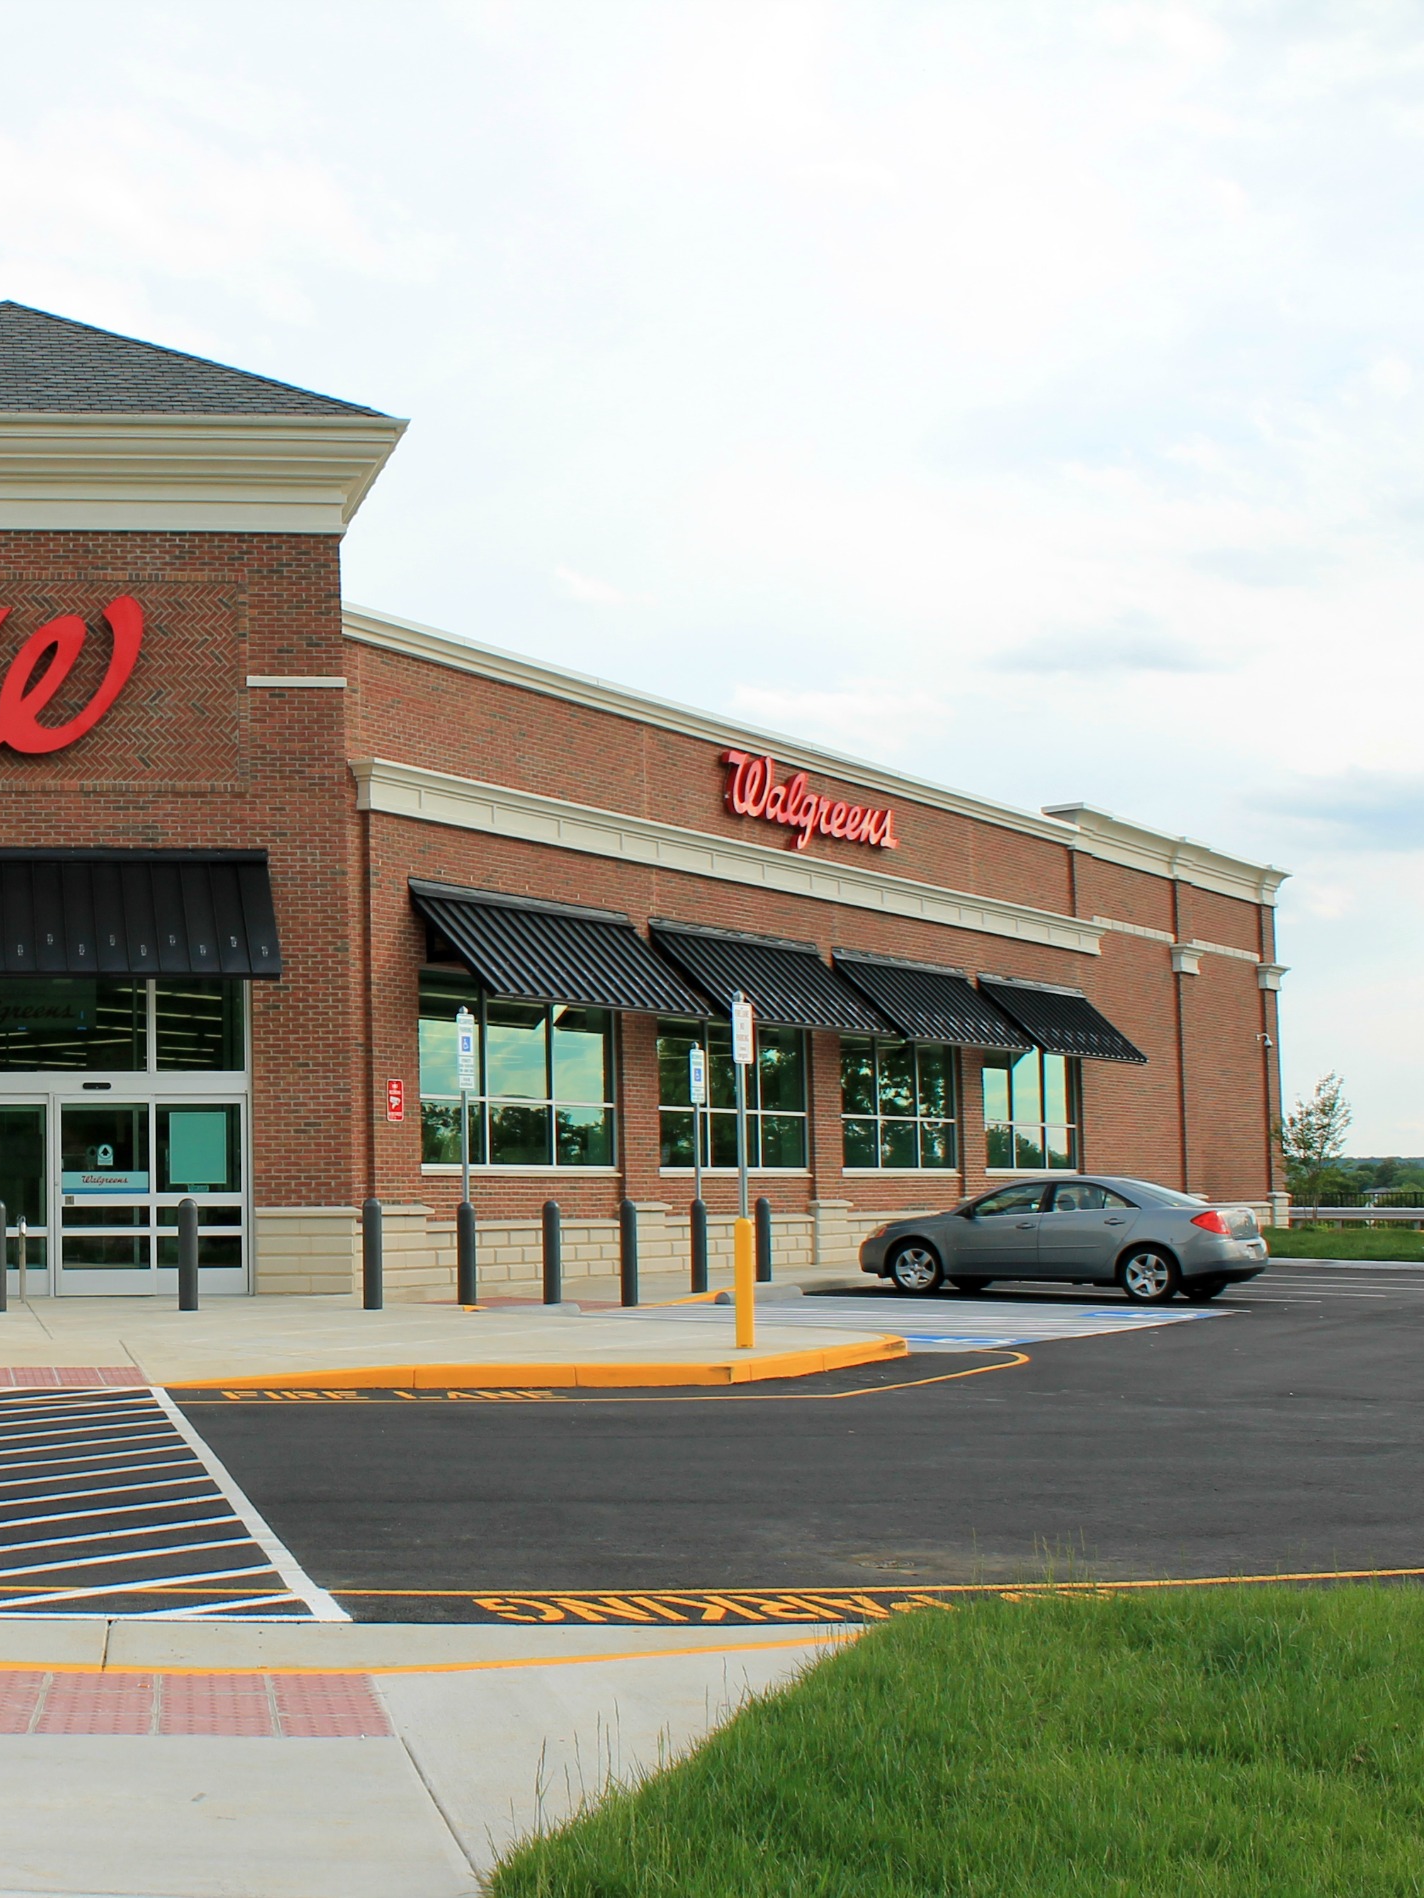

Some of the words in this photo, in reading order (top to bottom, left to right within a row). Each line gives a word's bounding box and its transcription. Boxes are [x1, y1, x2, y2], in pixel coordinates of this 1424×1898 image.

[721, 750, 900, 850] Walgreens
[81, 1175, 129, 1186] Walgreens
[220, 1390, 369, 1400] FIRE
[393, 1390, 568, 1400] LANE
